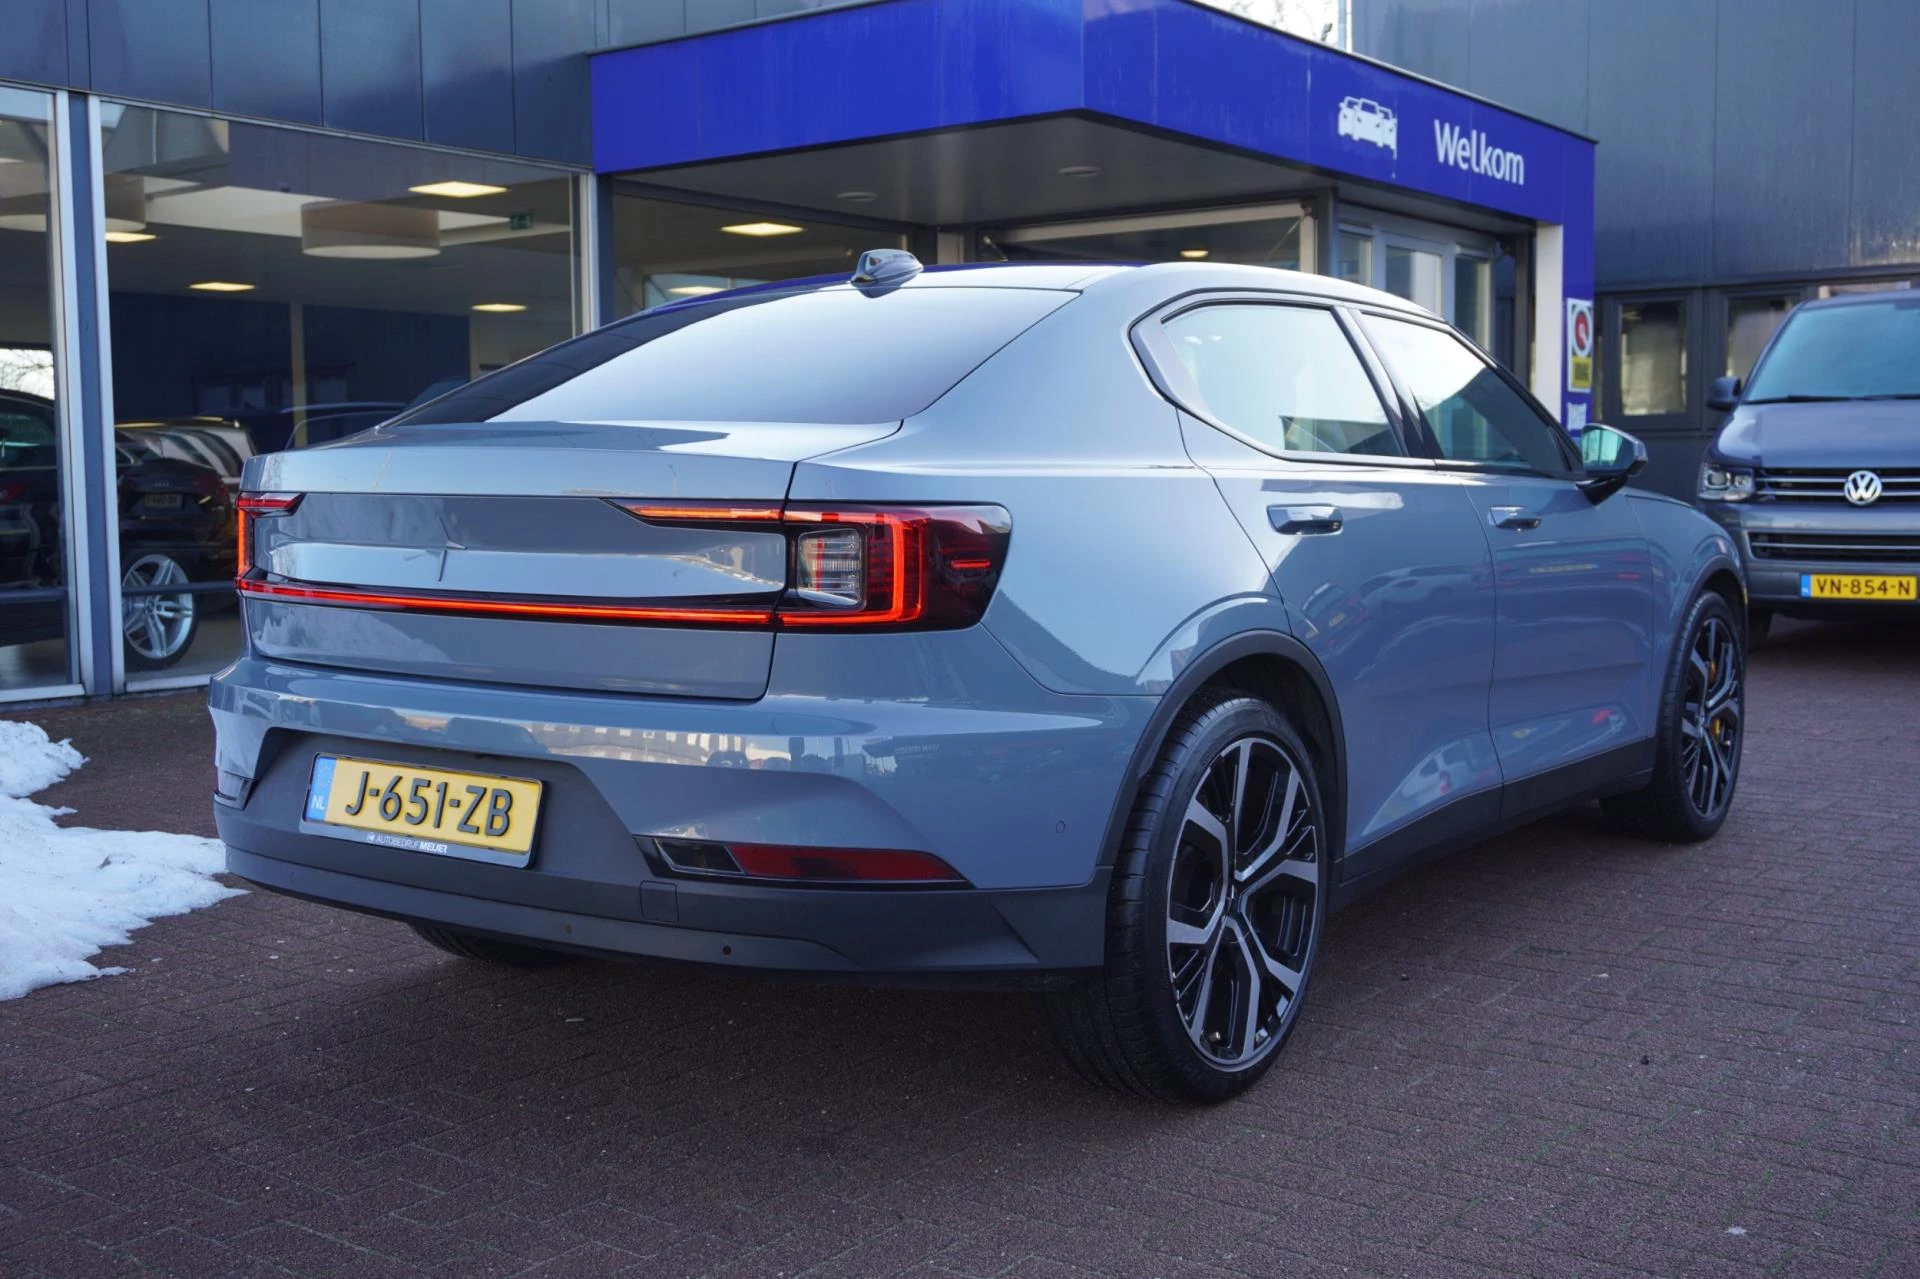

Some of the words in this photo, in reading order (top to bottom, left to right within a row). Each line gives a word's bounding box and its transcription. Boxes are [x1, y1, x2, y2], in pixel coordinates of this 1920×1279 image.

[1433, 118, 1525, 186] Welkom
[1816, 578, 1911, 596] VN-854-N
[311, 795, 325, 810] NL
[345, 771, 514, 837] J-651-ZB
